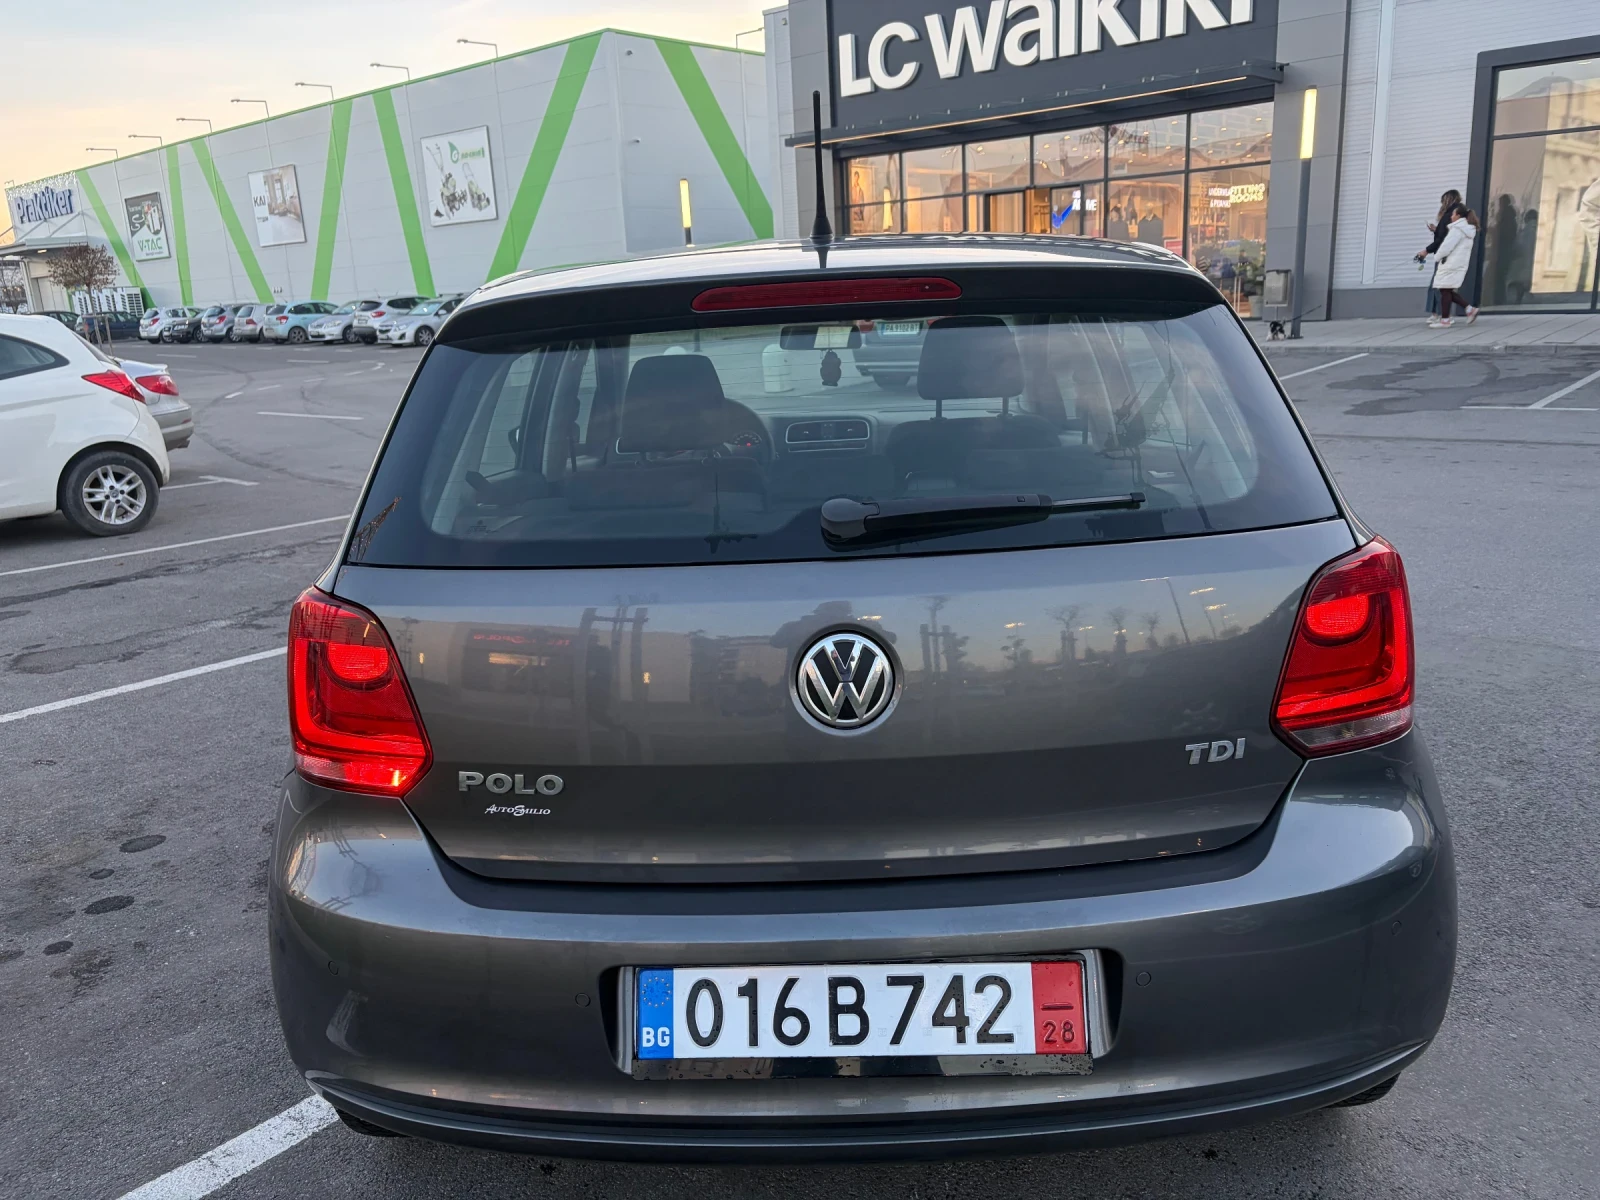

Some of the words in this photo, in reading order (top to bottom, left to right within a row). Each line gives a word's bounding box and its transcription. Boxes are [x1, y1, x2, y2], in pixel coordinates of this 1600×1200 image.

[838, 21, 921, 97] LC
[14, 186, 74, 224] Praktiker
[1229, 192, 1264, 204] ROOMS
[1185, 737, 1247, 765] TDI
[458, 770, 565, 796] POLO
[641, 1026, 671, 1049] BG
[1043, 1019, 1077, 1044] 28
